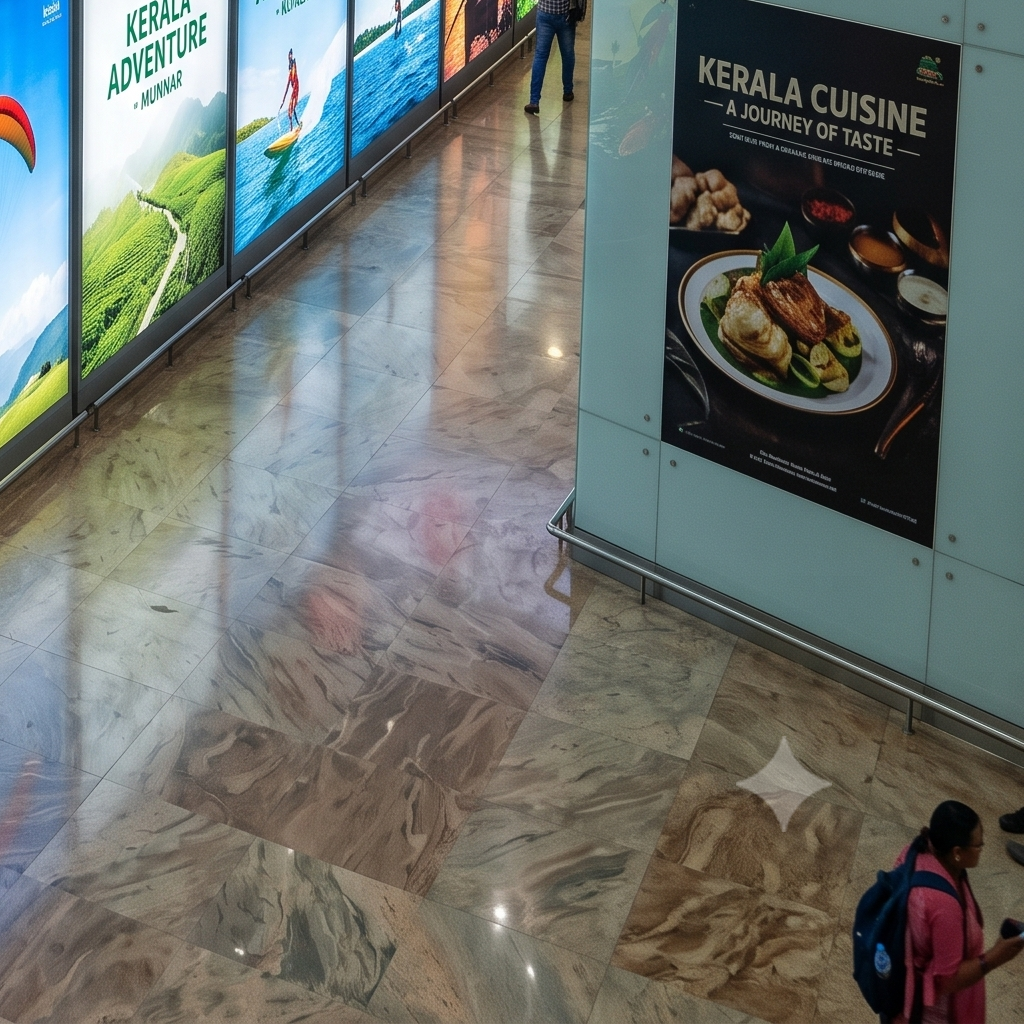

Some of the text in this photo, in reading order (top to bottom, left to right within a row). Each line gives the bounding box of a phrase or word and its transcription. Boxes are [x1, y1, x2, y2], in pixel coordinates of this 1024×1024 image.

[107, 12, 208, 100] ADVENTURE
[141, 69, 183, 110] MUNNAR
[698, 55, 928, 138] KERALA CUISINE
[726, 99, 737, 117] A
[740, 102, 813, 136] JOURNEY
[816, 122, 839, 141] OF
[842, 126, 894, 157] TASTE
